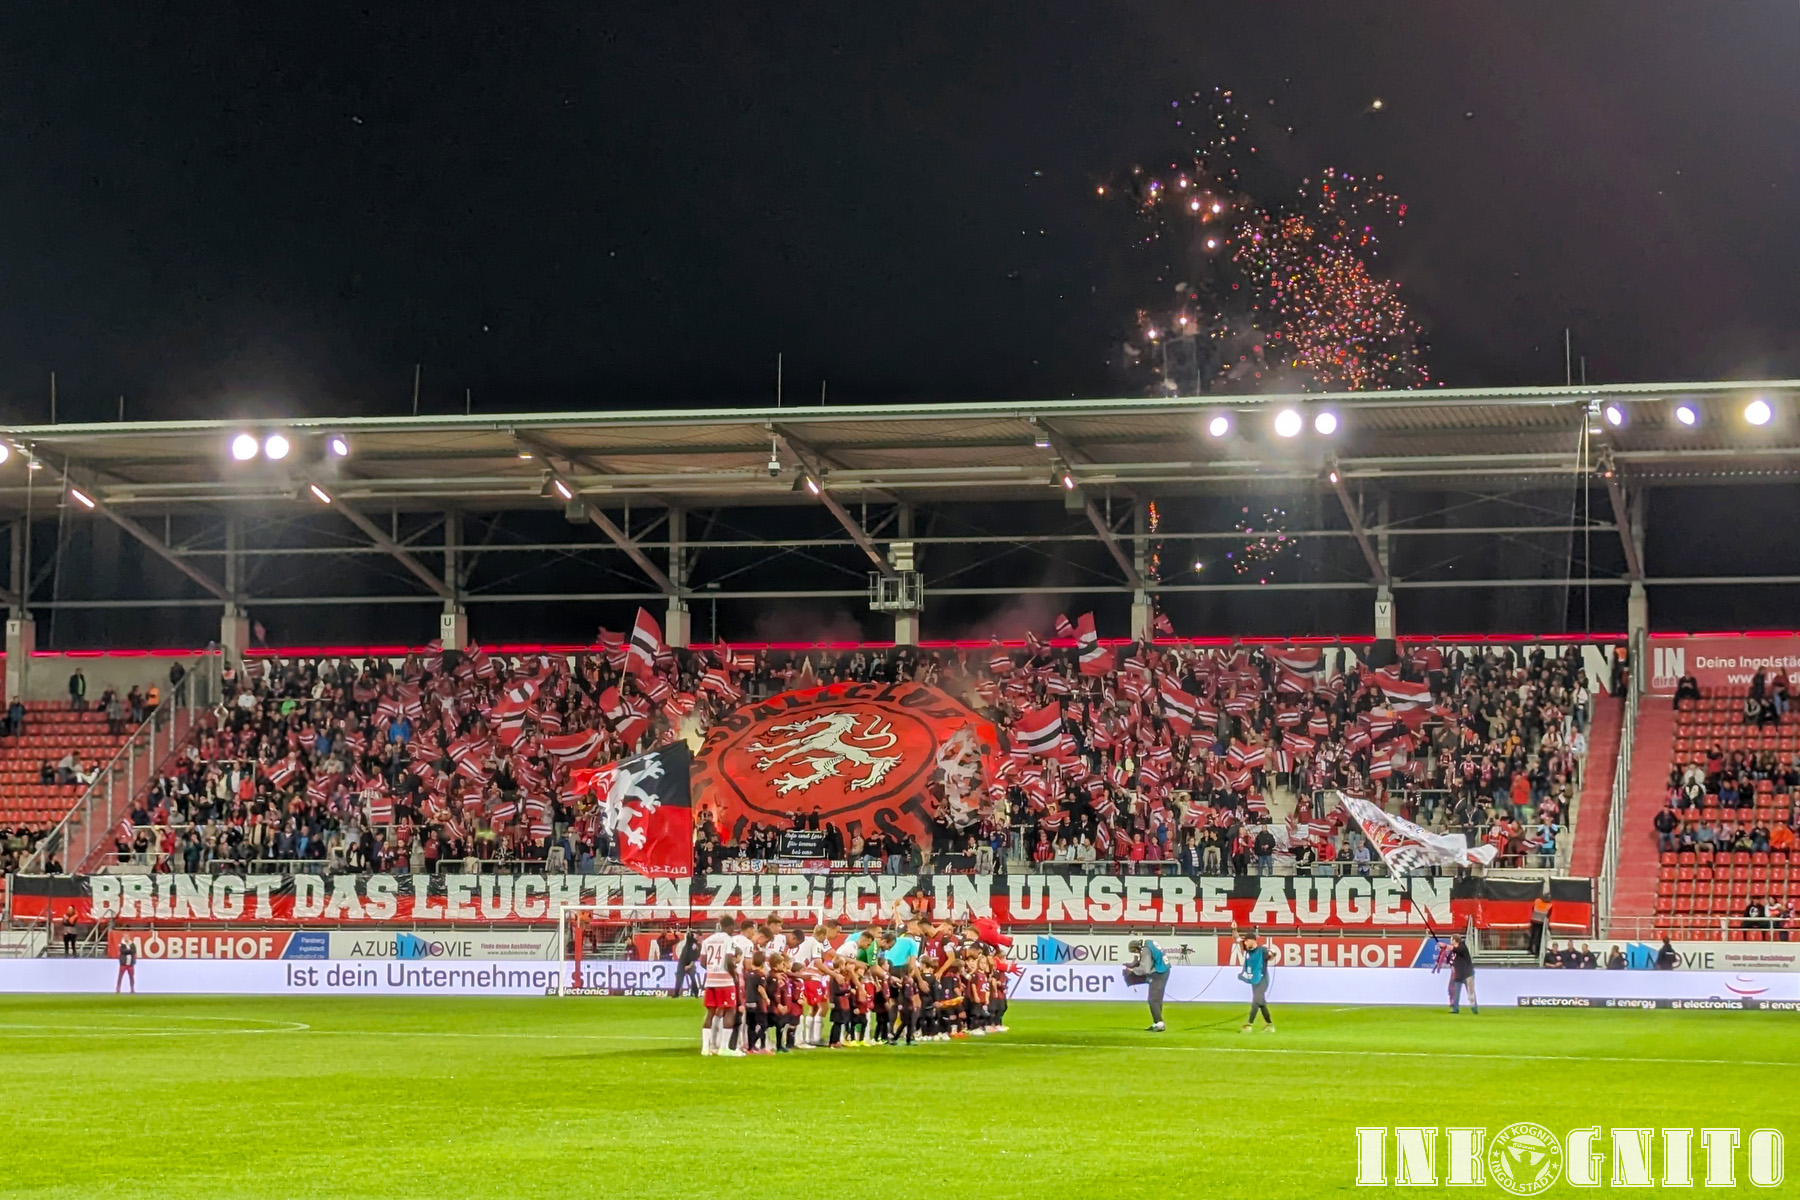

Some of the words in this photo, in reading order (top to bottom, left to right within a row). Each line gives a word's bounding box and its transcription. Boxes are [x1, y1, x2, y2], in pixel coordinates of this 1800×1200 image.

[1379, 605, 1387, 614] V
[10, 623, 16, 632] T
[444, 618, 452, 627] U
[1653, 647, 1685, 679] IN
[1696, 655, 1736, 668] Deine
[721, 859, 751, 872] FKS
[90, 874, 282, 919] BRINGT
[293, 874, 398, 920] DAS
[411, 874, 691, 920] LEUCHTEN
[932, 875, 993, 920] IN
[1007, 875, 1234, 923] UNSERE
[1249, 876, 1454, 925] AUGEN
[350, 941, 404, 957] AZUBI
[412, 941, 473, 957] MOVIE
[707, 945, 722, 965] 24
[1055, 944, 1119, 962] MOVIE
[287, 963, 318, 988] Ist
[326, 963, 378, 988] dein
[387, 963, 560, 989] Unternehmen
[571, 964, 666, 989] sicher?
[1030, 967, 1115, 993] sicher
[634, 988, 668, 998] energy
[1520, 997, 1530, 1006] si
[1531, 997, 1590, 1007] electronics
[1606, 999, 1613, 1008] si
[1614, 1001, 1656, 1010] energy
[1671, 999, 1681, 1009] si
[1683, 1000, 1743, 1009] electronics
[1760, 1000, 1769, 1009] si
